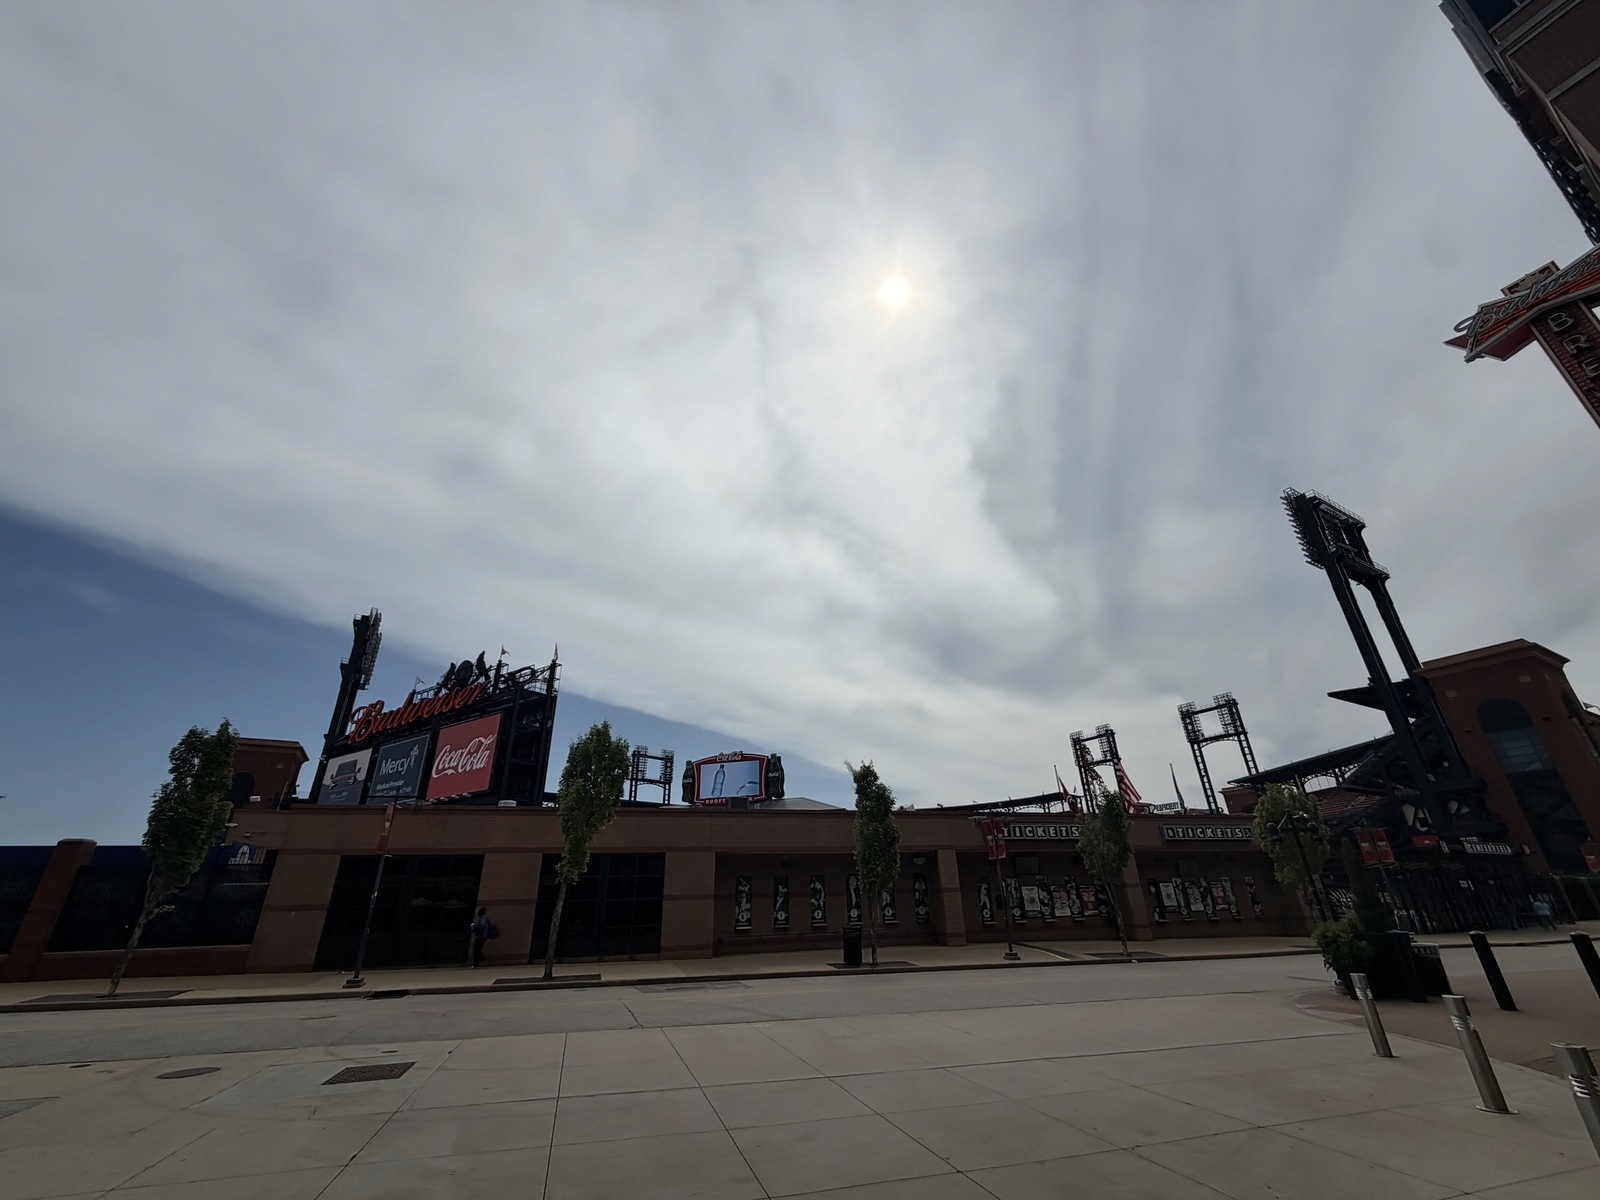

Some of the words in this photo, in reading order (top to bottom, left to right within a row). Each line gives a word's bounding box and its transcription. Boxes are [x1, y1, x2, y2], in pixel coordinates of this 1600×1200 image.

[1546, 311, 1600, 398] BRE
[348, 681, 487, 744] Budweiser
[379, 756, 411, 776] Mercy
[432, 734, 497, 778] Coca-Cola
[1002, 826, 1079, 837] TICKETS
[1176, 828, 1242, 838] TICKETS
